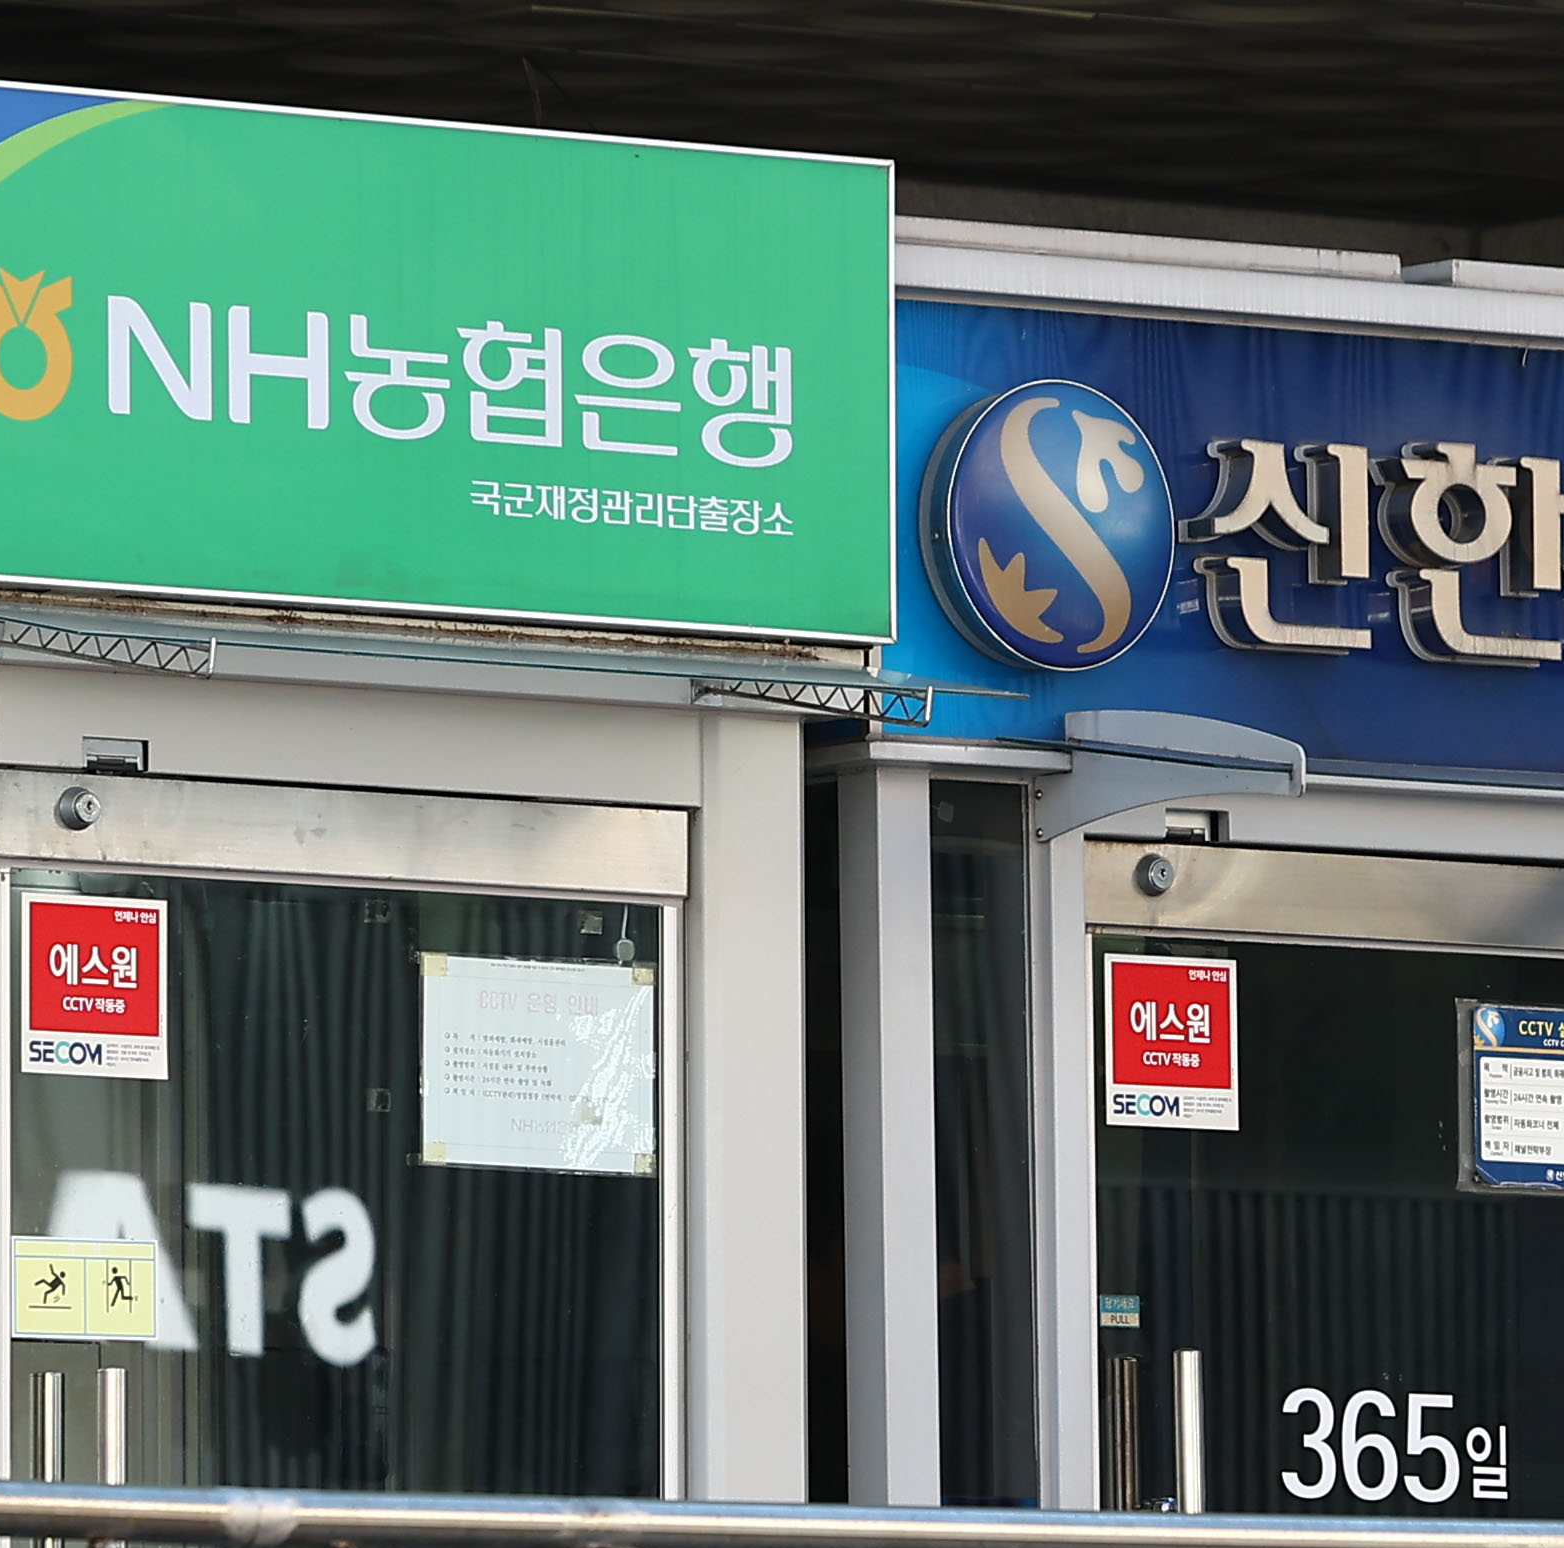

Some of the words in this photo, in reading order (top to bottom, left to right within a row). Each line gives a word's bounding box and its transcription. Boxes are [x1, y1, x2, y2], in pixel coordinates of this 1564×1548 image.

[469, 480, 795, 538] 국군재정관리단출장소
[49, 943, 138, 989] 에스원
[62, 996, 94, 1012] CCTV
[94, 997, 126, 1014] 작동중
[1130, 1001, 1211, 1043] 에스원
[1518, 1020, 1553, 1037] CCTV
[29, 1040, 102, 1066] SECOM
[1143, 1051, 1172, 1066] CCTV
[1172, 1052, 1200, 1067] 작동중
[1113, 1094, 1180, 1117] SECOM
